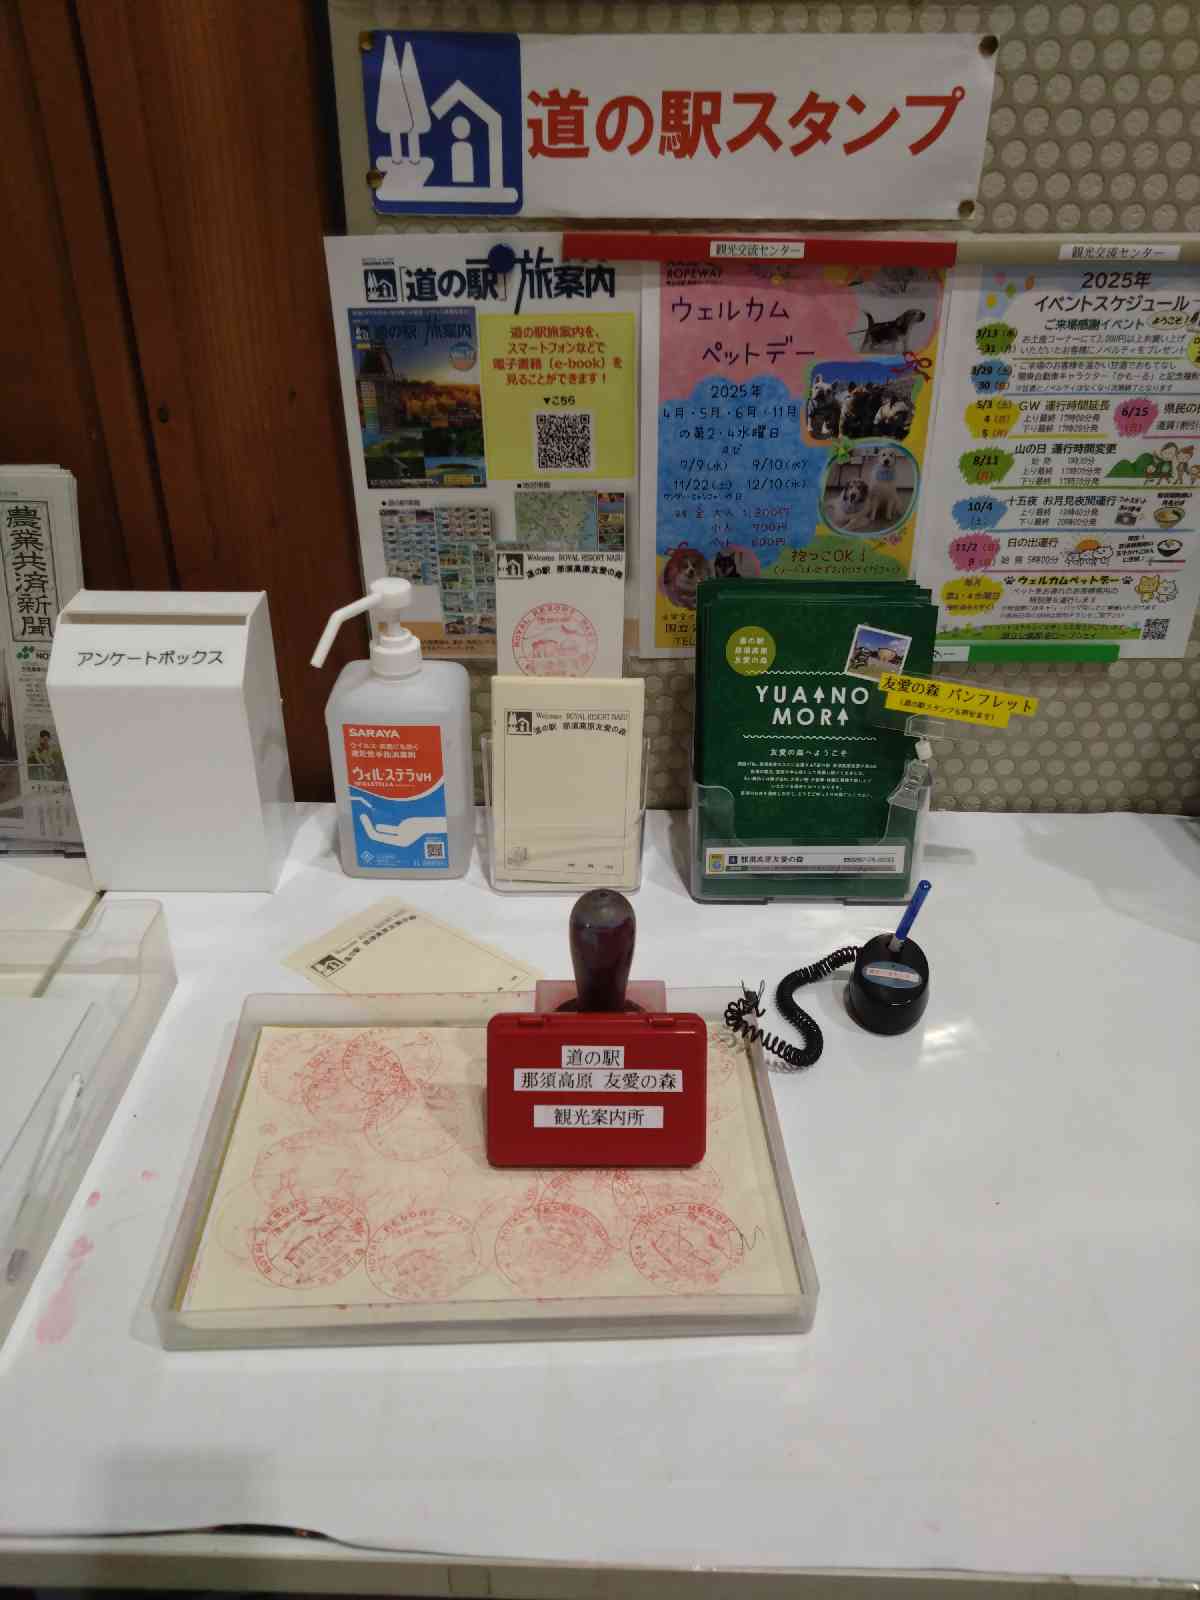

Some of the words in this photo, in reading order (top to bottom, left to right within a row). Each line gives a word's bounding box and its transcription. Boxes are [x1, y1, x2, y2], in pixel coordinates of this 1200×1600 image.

[527, 87, 967, 160] 道の駅スタンプ
[1080, 271, 1152, 290] 2025年
[671, 295, 790, 322] ウェルカム
[1034, 295, 1189, 312] イベントスケジュール
[702, 335, 816, 364] ペットデー
[710, 384, 762, 400] 2025年
[1120, 407, 1149, 418] 6/15
[1015, 444, 1047, 455] 山の日
[967, 502, 993, 513] 10/4
[6, 504, 55, 639] 農業共済新聞
[77, 650, 224, 667] アンケートボックス
[348, 728, 400, 738] SARAYA
[565, 1047, 621, 1067] 道の駅
[521, 1071, 593, 1090] 那須高原
[604, 1071, 677, 1090] 友愛の森
[554, 1107, 646, 1127] 観光案内所
